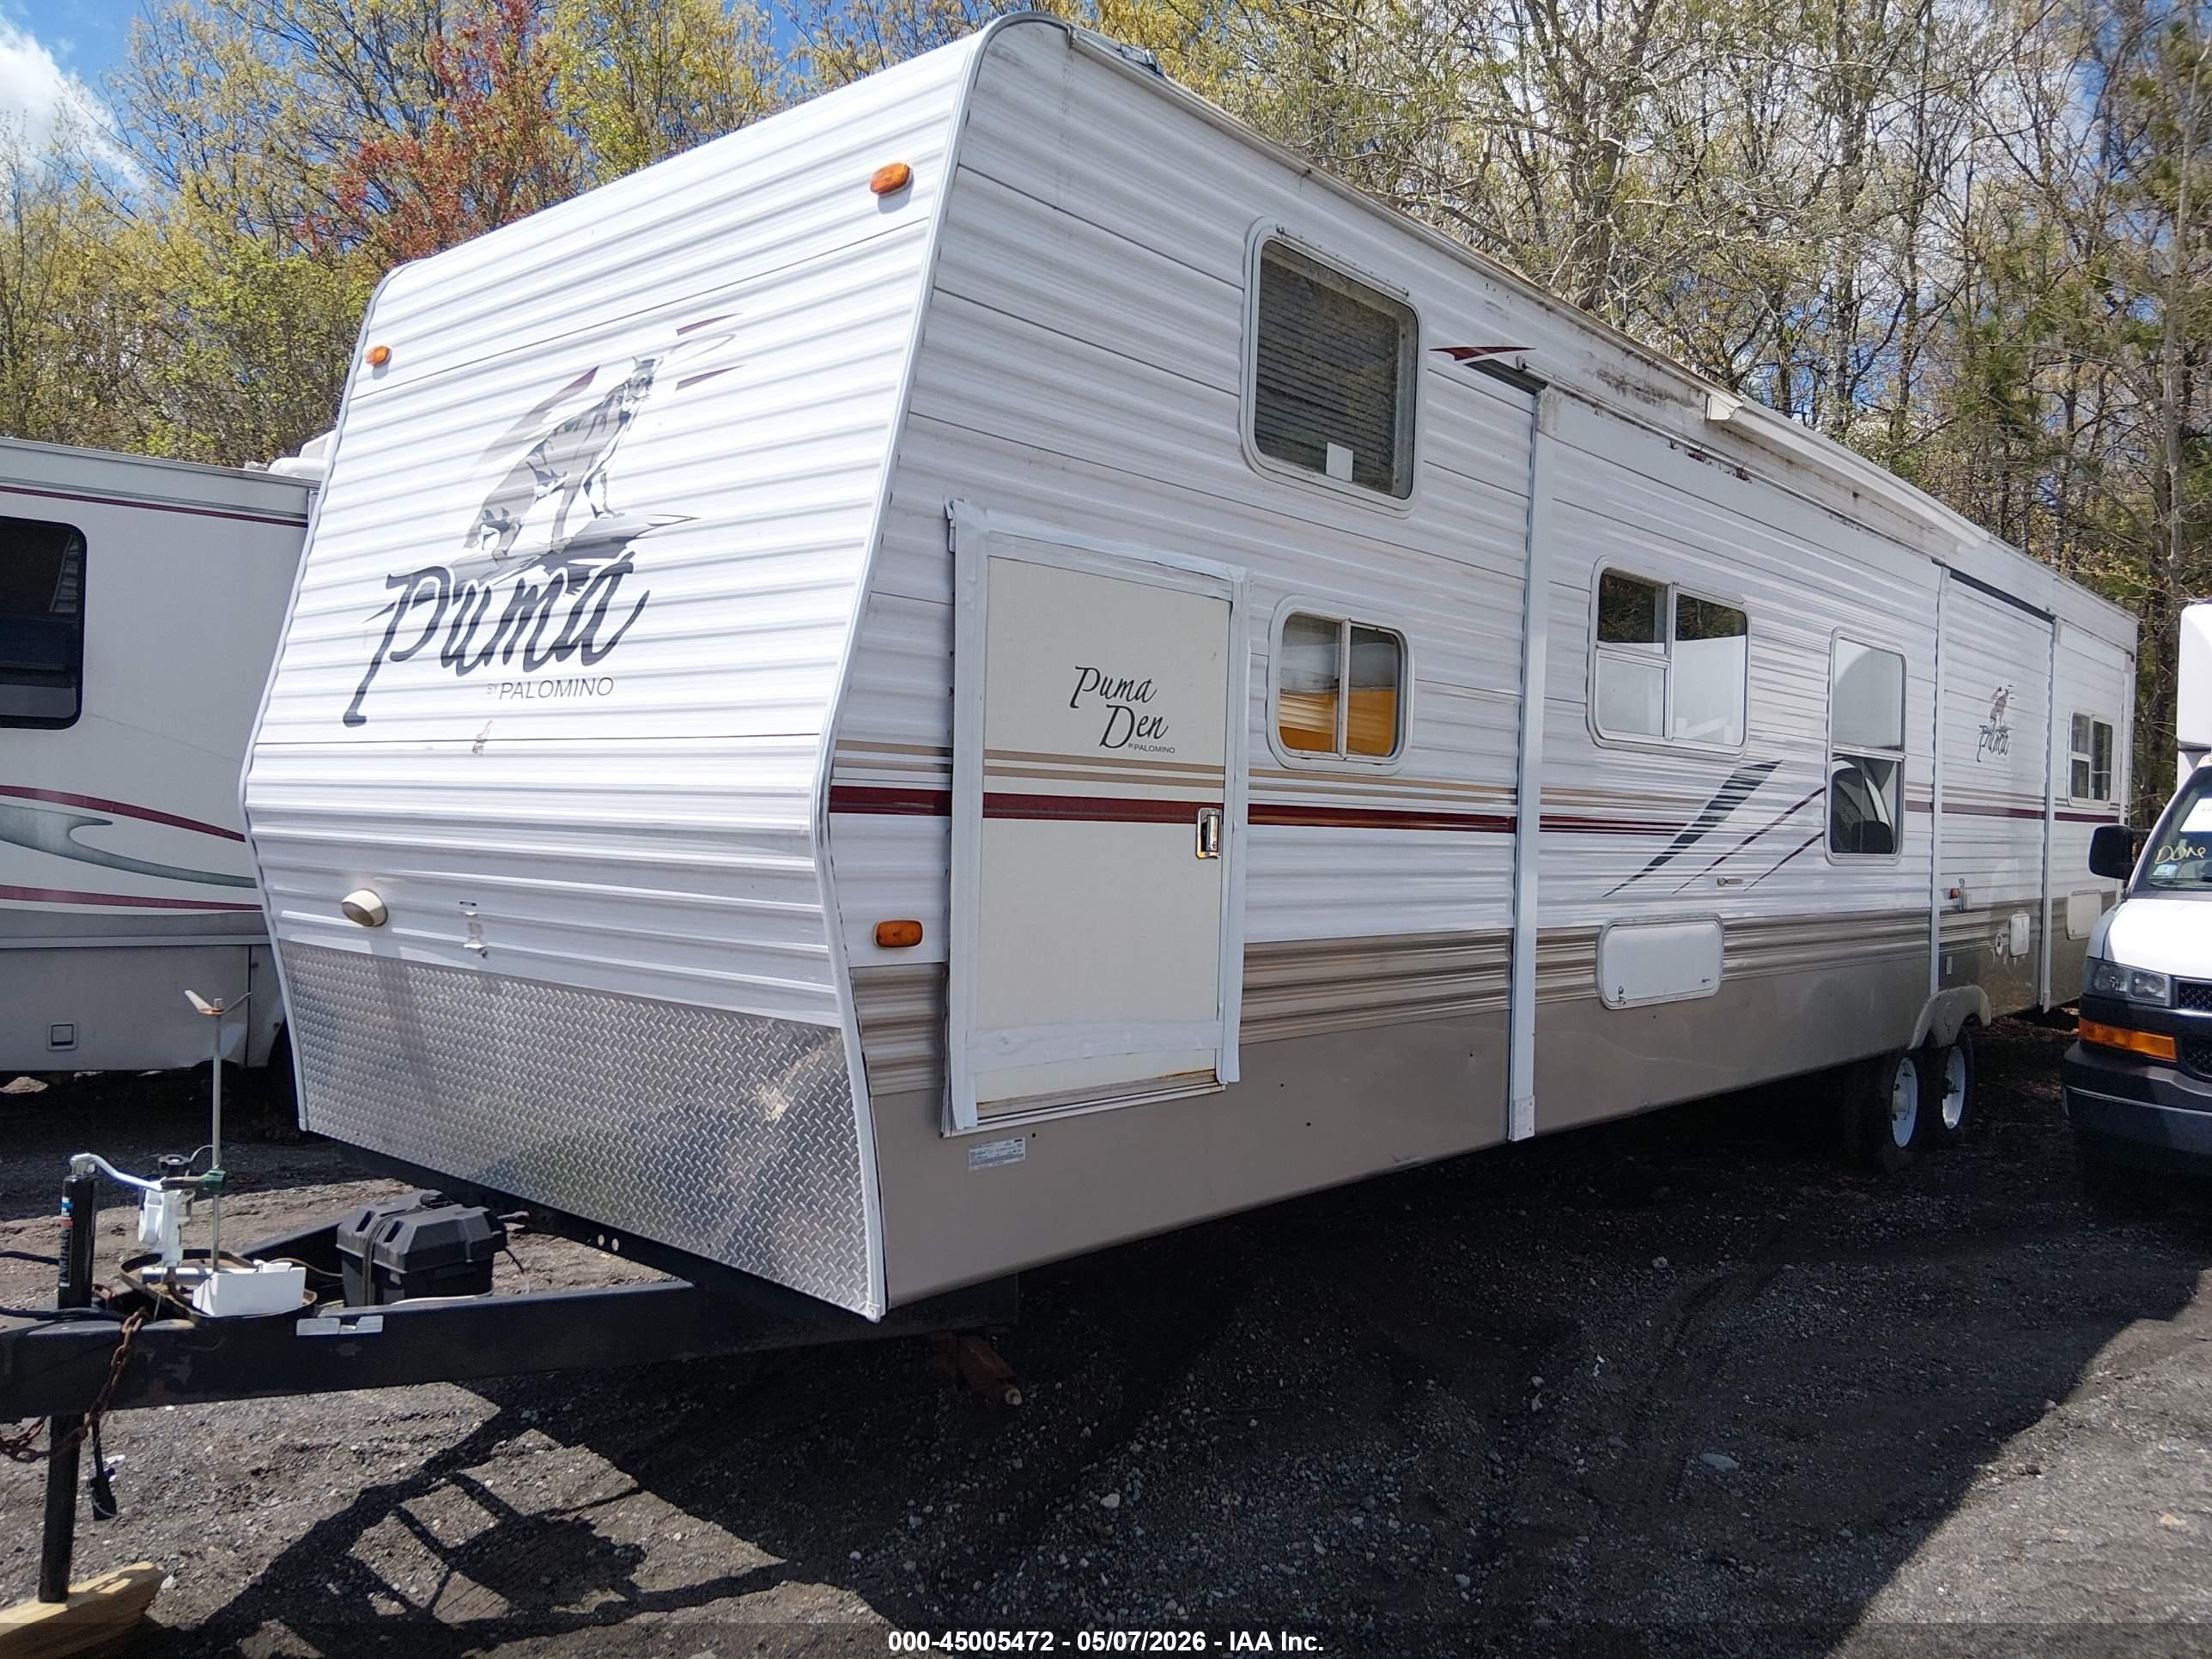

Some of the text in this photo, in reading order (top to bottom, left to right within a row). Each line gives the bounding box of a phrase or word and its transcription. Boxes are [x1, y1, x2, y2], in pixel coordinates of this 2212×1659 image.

[343, 551, 650, 727] Puma
[499, 677, 614, 700] PALOMINO
[1070, 665, 1158, 709] Puma
[1099, 704, 1169, 748] Den
[1133, 744, 1176, 754] PALOMINO
